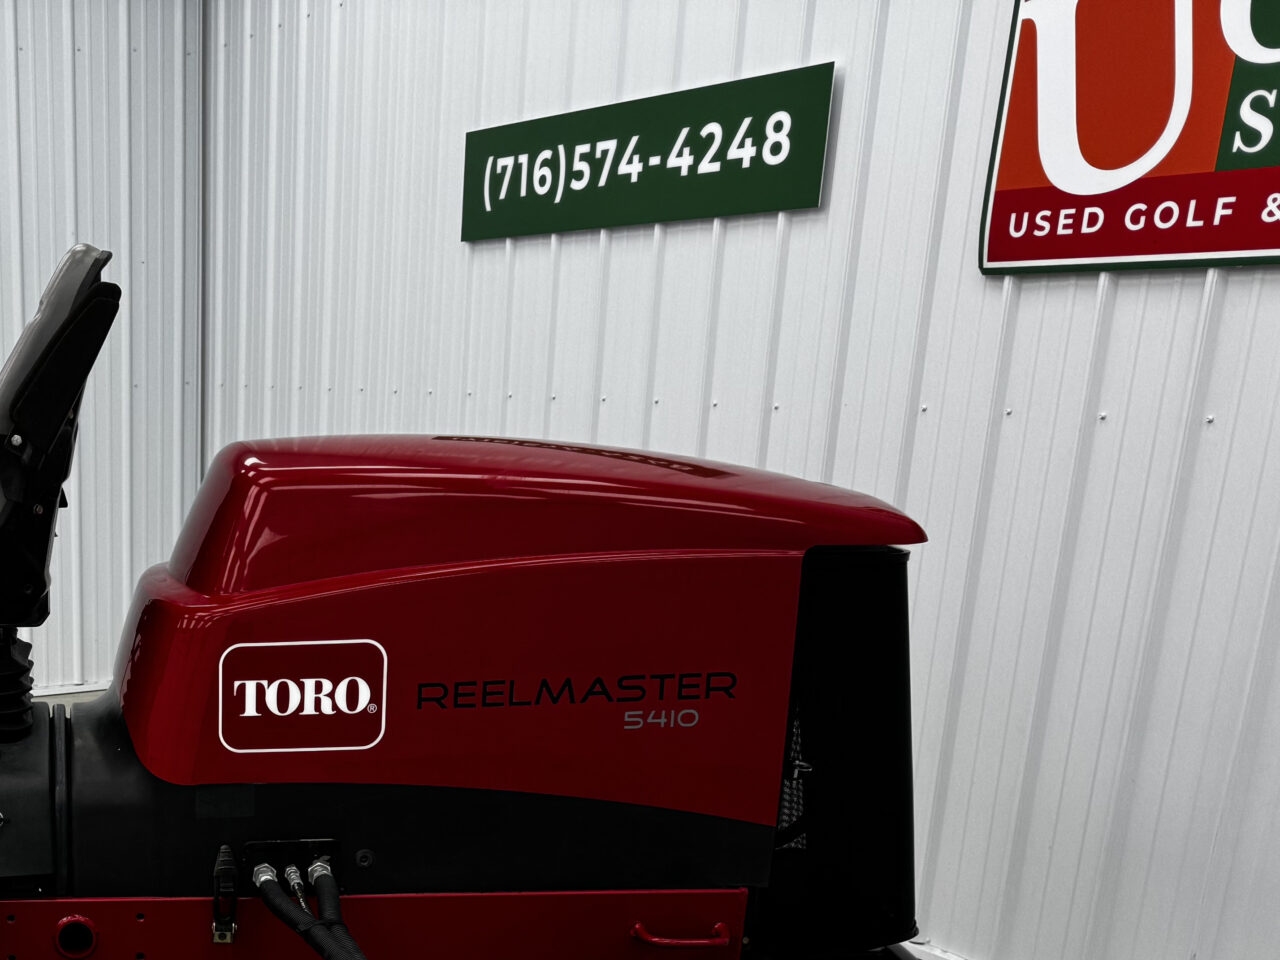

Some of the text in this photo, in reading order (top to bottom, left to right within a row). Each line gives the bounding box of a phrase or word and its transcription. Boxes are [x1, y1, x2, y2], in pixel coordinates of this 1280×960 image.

[483, 110, 793, 212] (716)574-4248
[1008, 206, 1105, 238] USED
[1124, 196, 1237, 231] GOLF
[416, 672, 738, 710] REELMASTER
[623, 709, 700, 730] 5410
